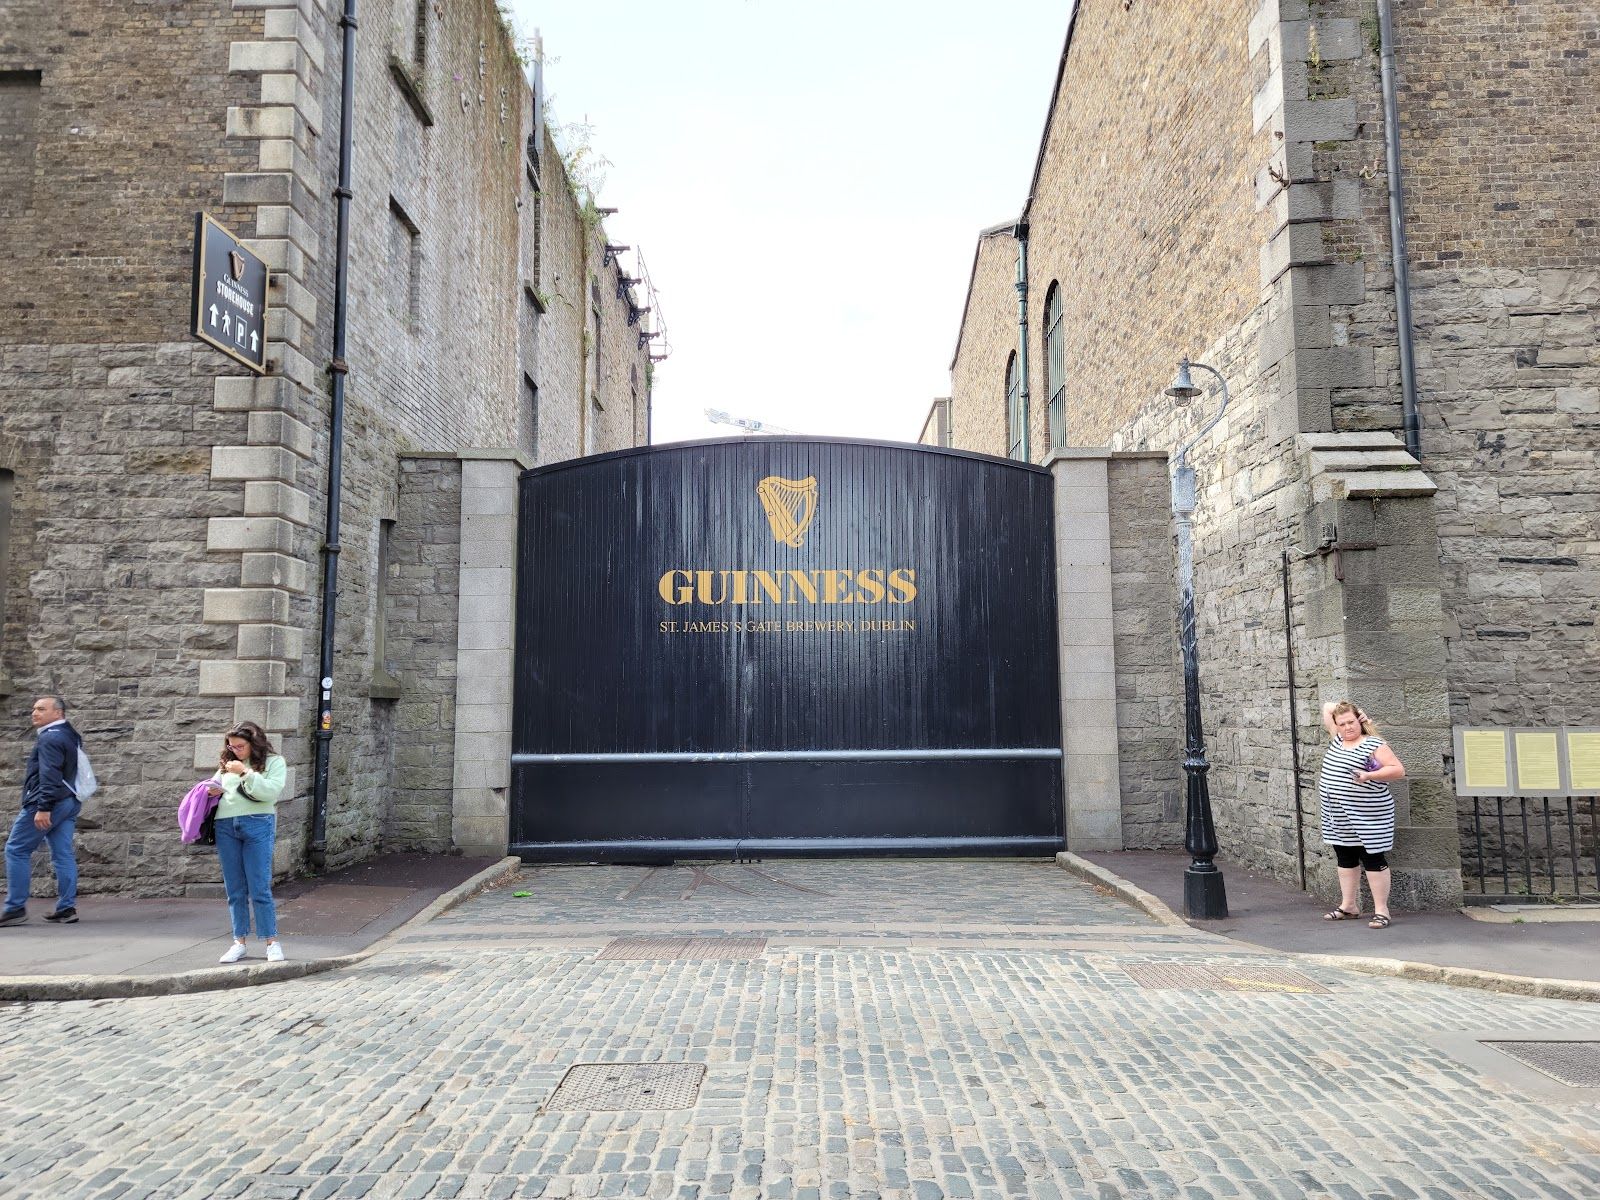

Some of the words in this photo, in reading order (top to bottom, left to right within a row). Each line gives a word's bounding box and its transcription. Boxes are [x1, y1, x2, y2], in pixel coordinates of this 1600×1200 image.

[223, 273, 249, 298] GUINNESS
[216, 280, 254, 317] STOREHOUSE
[237, 322, 245, 343] P
[658, 569, 917, 605] GUINNESS
[659, 621, 679, 633] ST.
[747, 620, 782, 632] GATE
[786, 620, 858, 634] BREWERY,
[860, 620, 915, 632] DUBLIN
